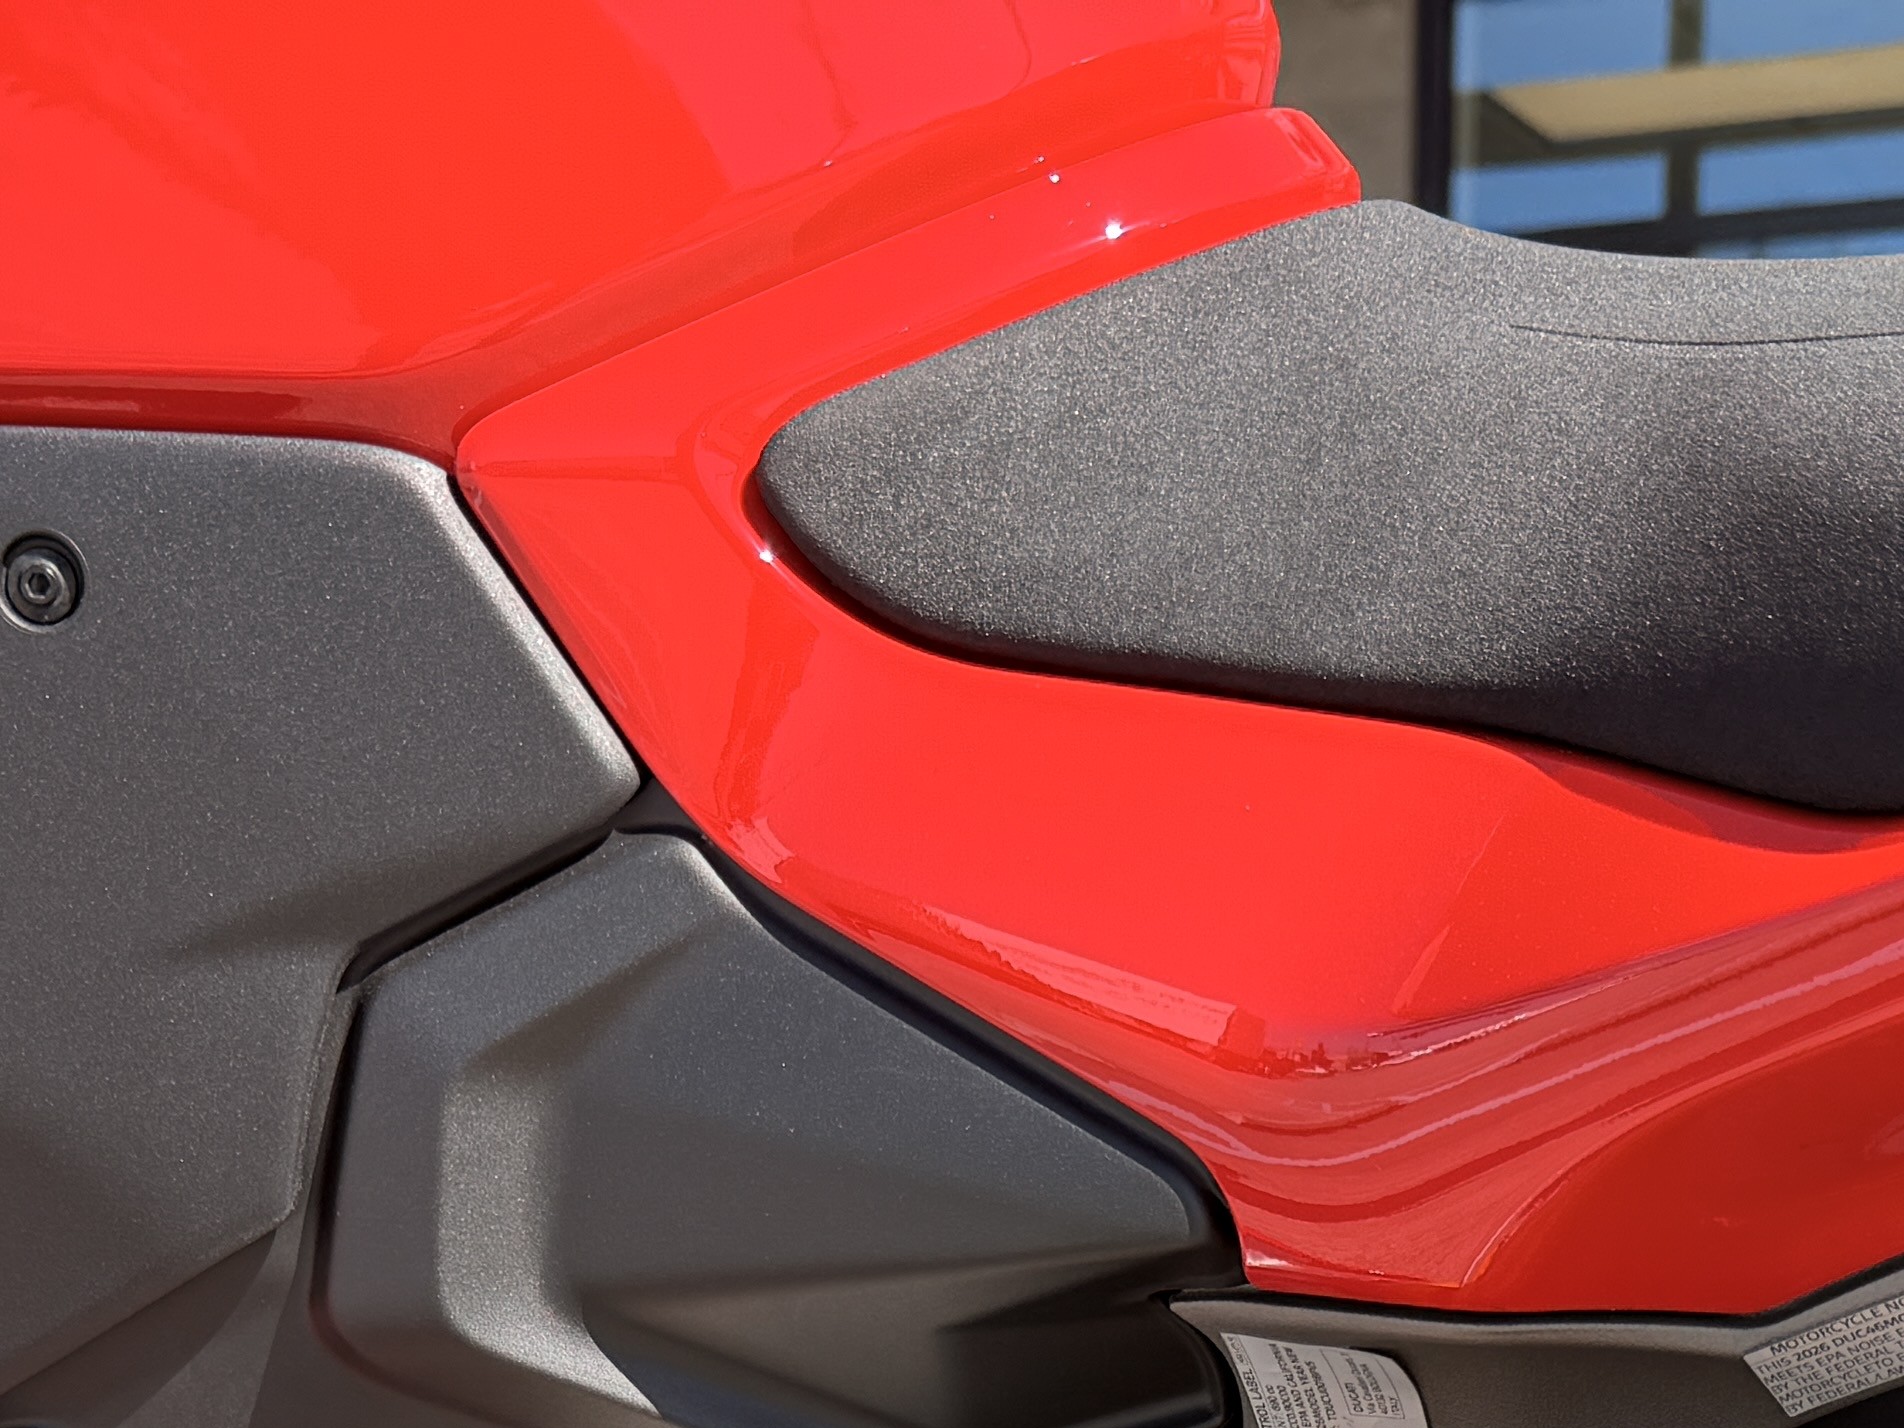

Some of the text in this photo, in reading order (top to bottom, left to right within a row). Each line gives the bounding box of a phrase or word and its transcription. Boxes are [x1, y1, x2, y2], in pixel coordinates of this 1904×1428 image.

[1769, 1308, 1882, 1355] MOTORCYCLE
[1269, 1344, 1297, 1387] CALIFORNIA
[1755, 1357, 1790, 1375] THIS
[1792, 1343, 1829, 1361] 2026
[1762, 1362, 1813, 1385] MEETS
[1815, 1351, 1844, 1366] EPA
[1846, 1333, 1893, 1355] NOISE
[1770, 1383, 1790, 1394] BY
[1792, 1372, 1821, 1387] THE
[1824, 1346, 1891, 1375] FEDERAL
[1242, 1369, 1263, 1400] LABEL
[1291, 1390, 1305, 1409] AND
[1777, 1365, 1874, 1404] MOTORCYCLE
[1872, 1358, 1893, 1370] TO
[1784, 1402, 1804, 1413] BY
[1807, 1378, 1871, 1405] FEDERAL
[1298, 1411, 1311, 1427] EPA
